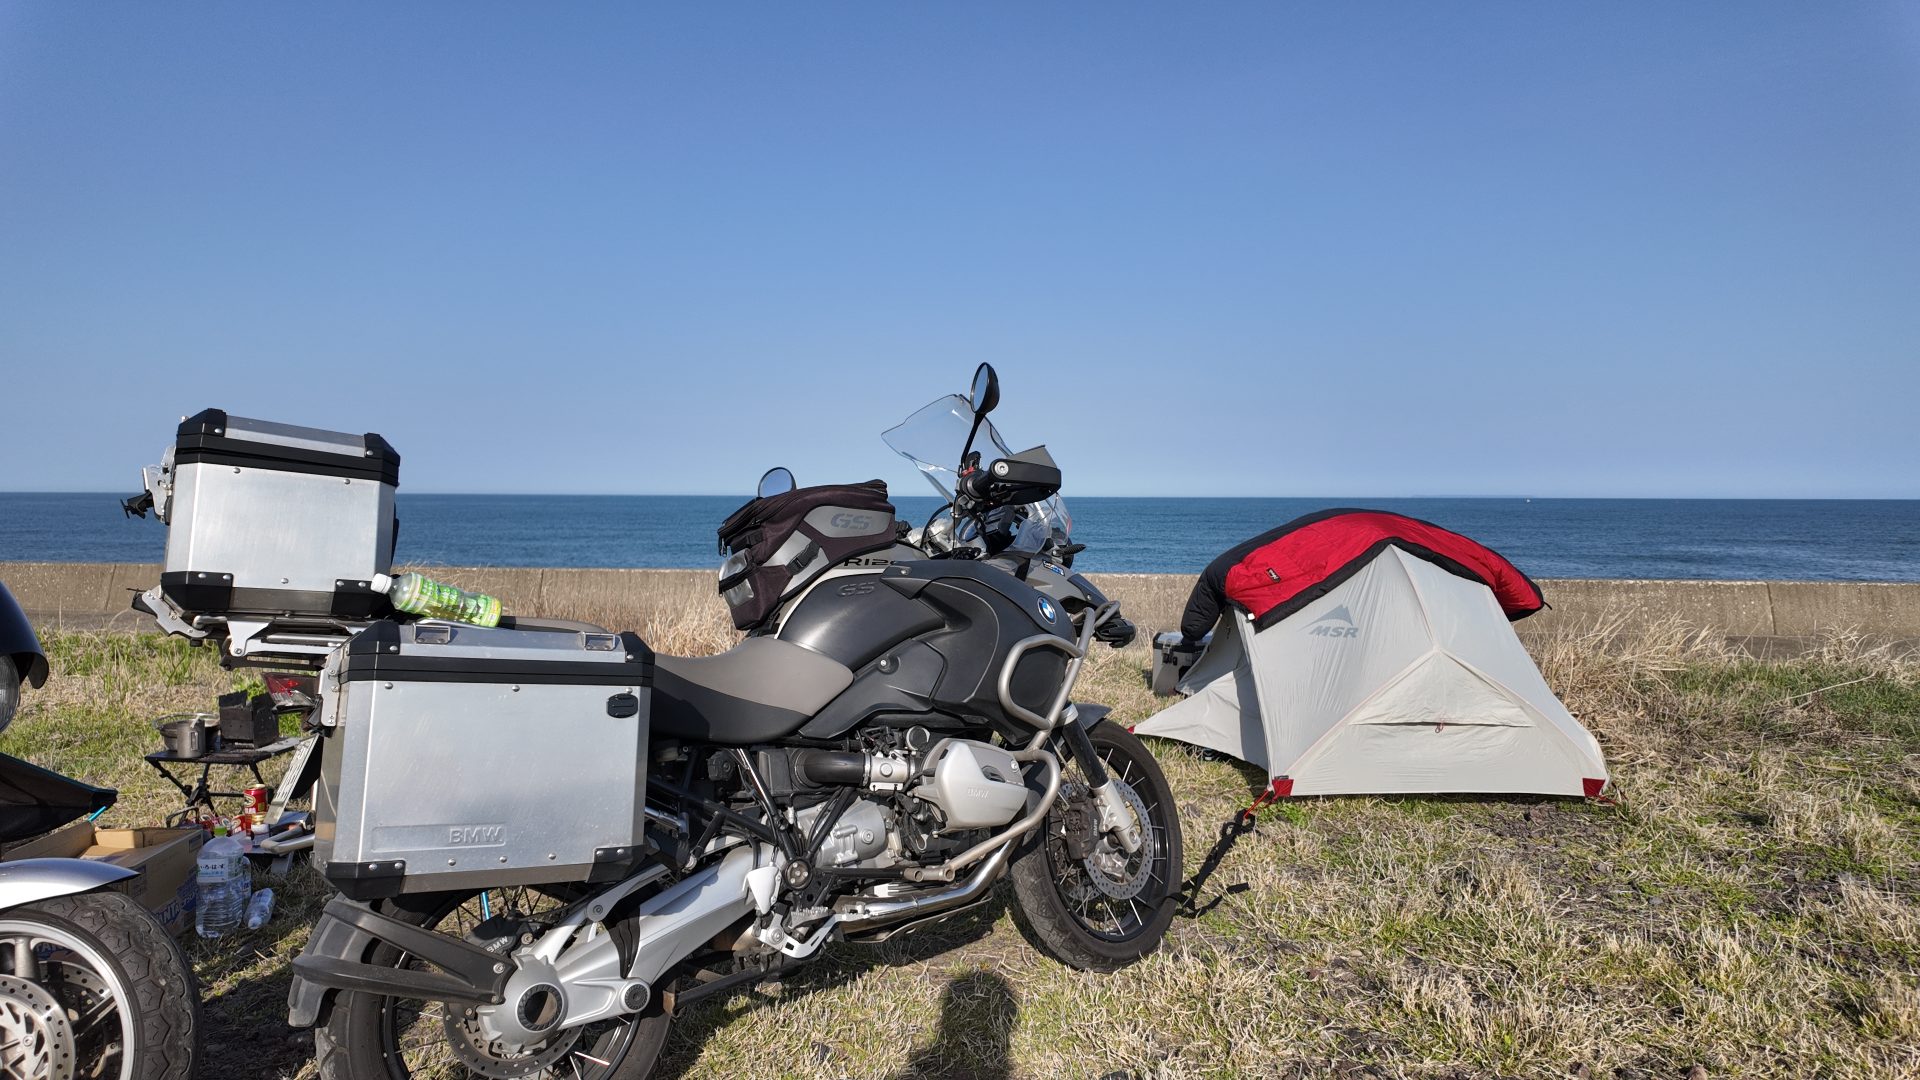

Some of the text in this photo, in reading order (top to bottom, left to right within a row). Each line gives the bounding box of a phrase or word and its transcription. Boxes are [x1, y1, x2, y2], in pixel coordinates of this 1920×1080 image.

[831, 513, 872, 529] GS
[843, 558, 897, 567] R12
[837, 582, 876, 597] GS
[1309, 626, 1359, 638] MSR
[449, 825, 502, 843] BMW
